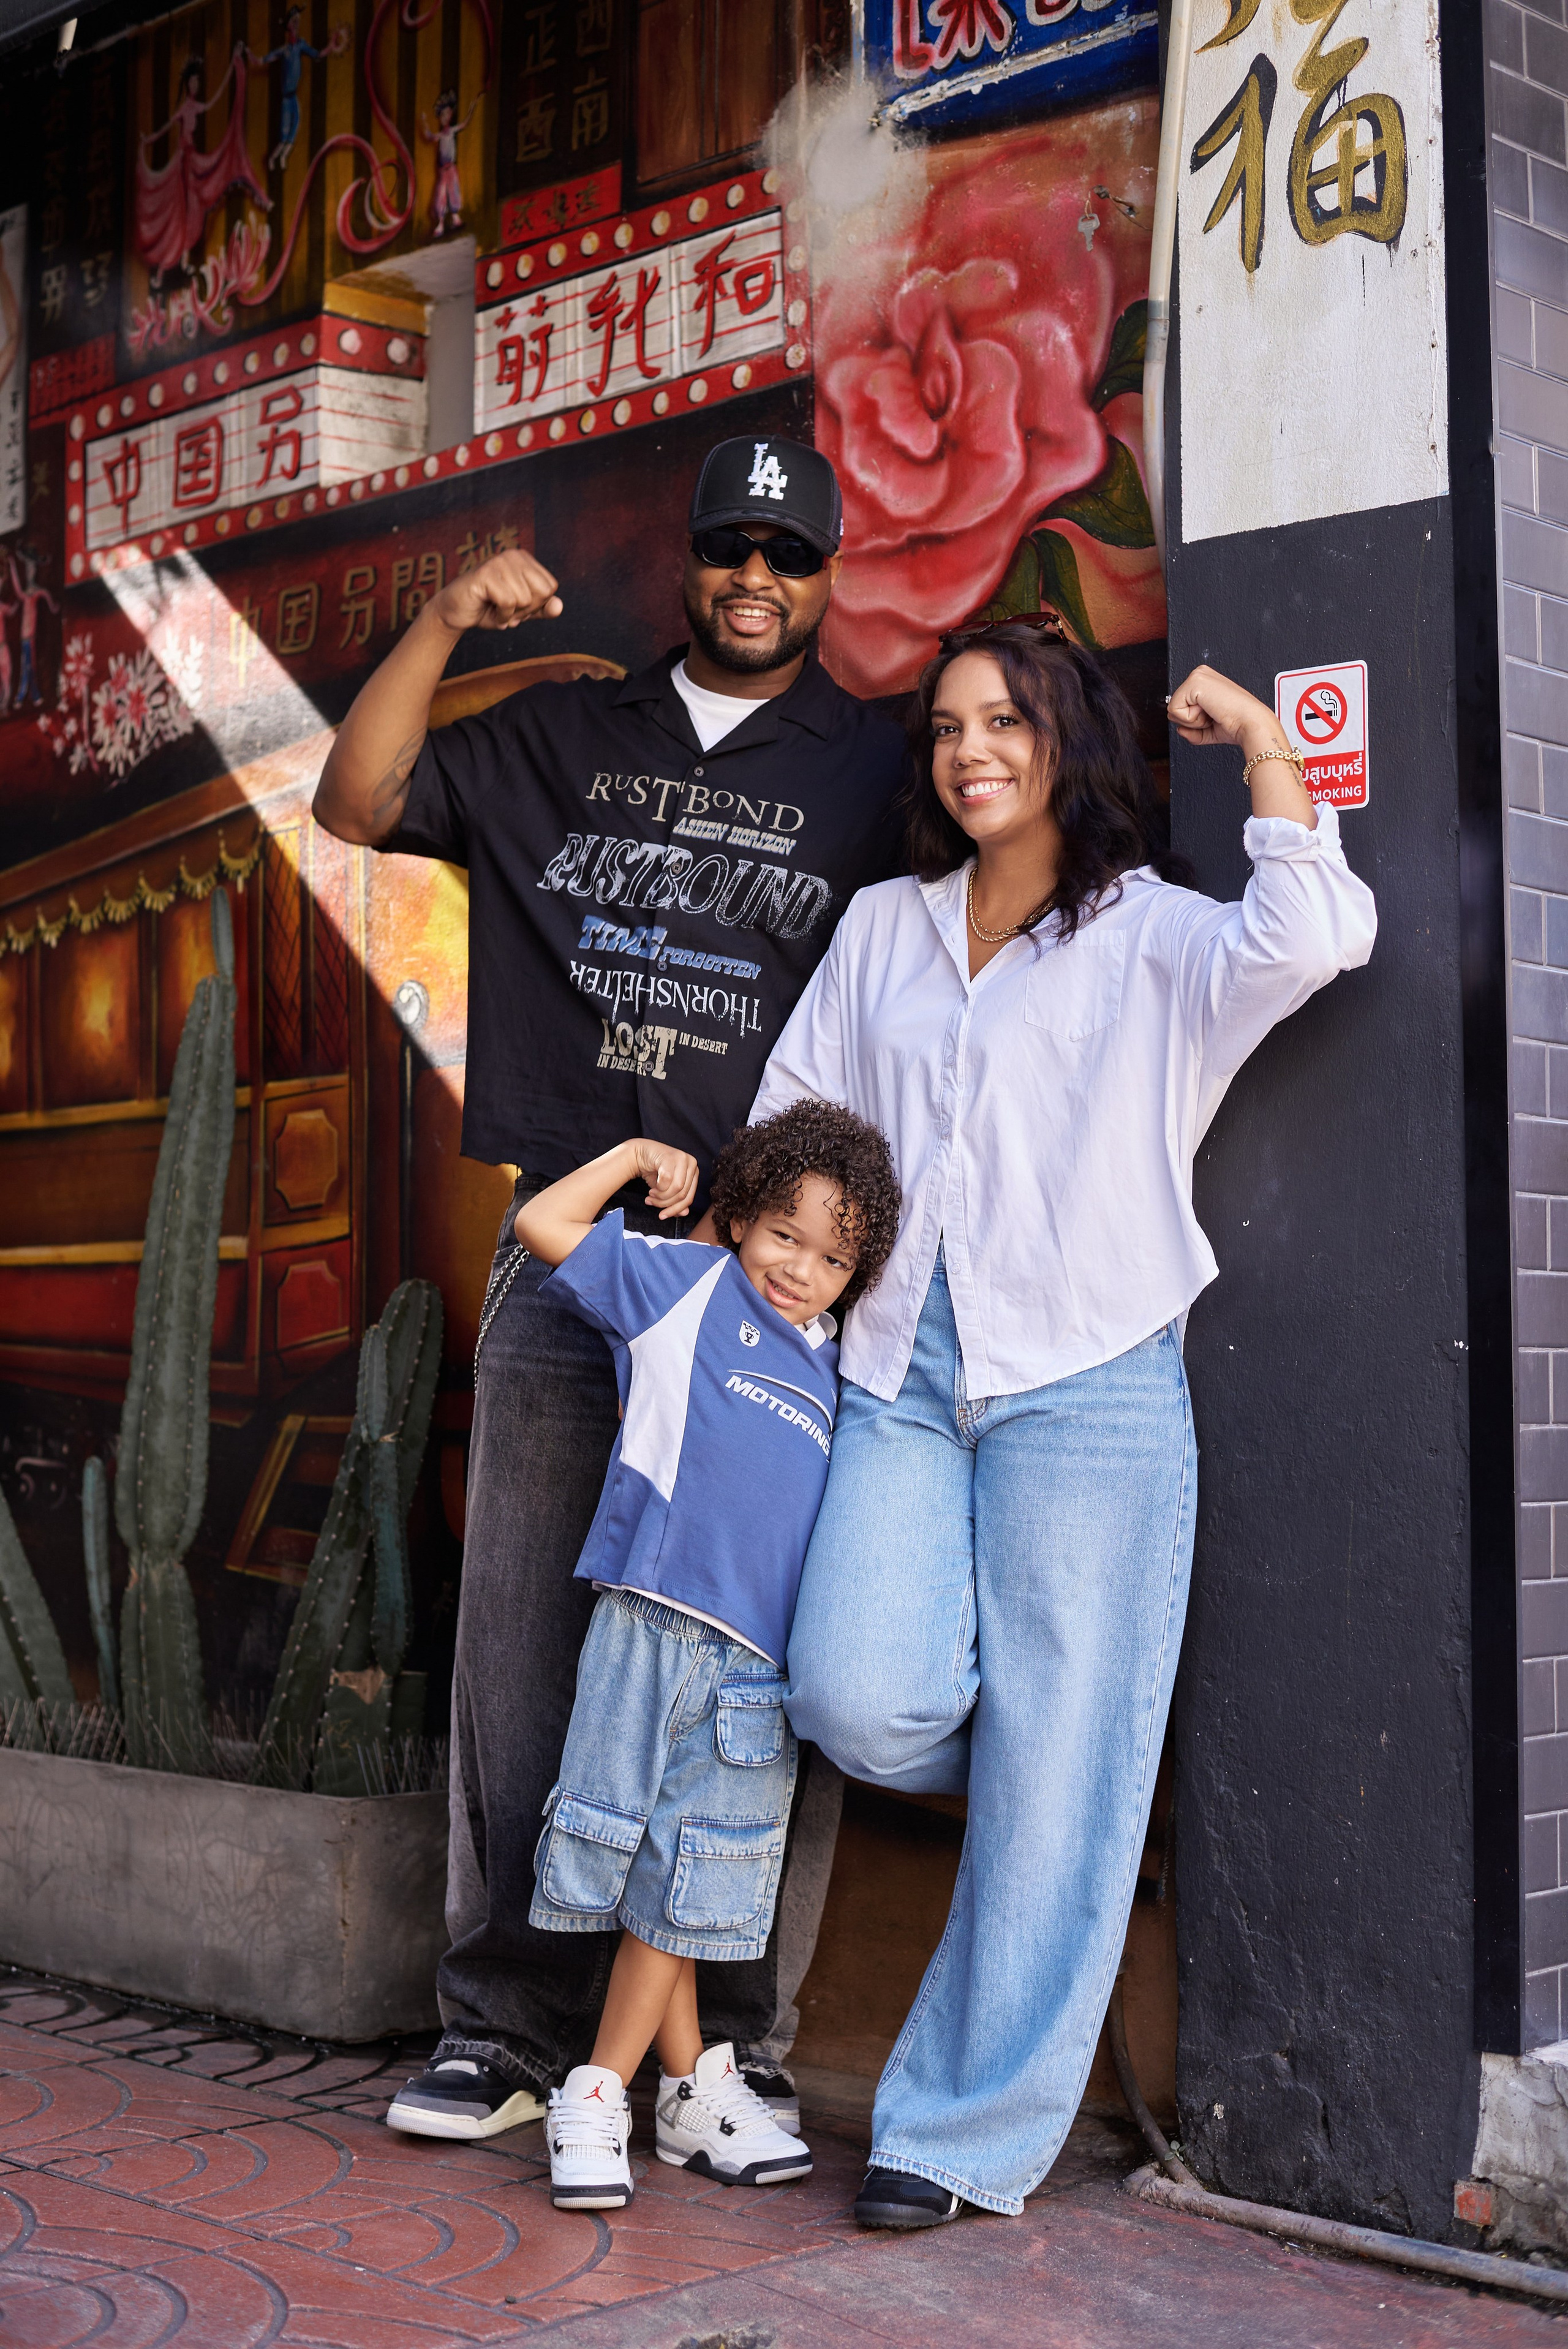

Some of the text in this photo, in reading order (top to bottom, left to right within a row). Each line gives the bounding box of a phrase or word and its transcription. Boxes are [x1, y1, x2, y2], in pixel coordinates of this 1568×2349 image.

[747, 442, 788, 500] LA
[673, 816, 797, 856] ASHEN HORIZON
[658, 946, 762, 980] FORGOTTEN
[597, 1053, 611, 1068] IN
[600, 1017, 729, 1080] LOST IN DESERT
[725, 1374, 831, 1457] MOTORING
